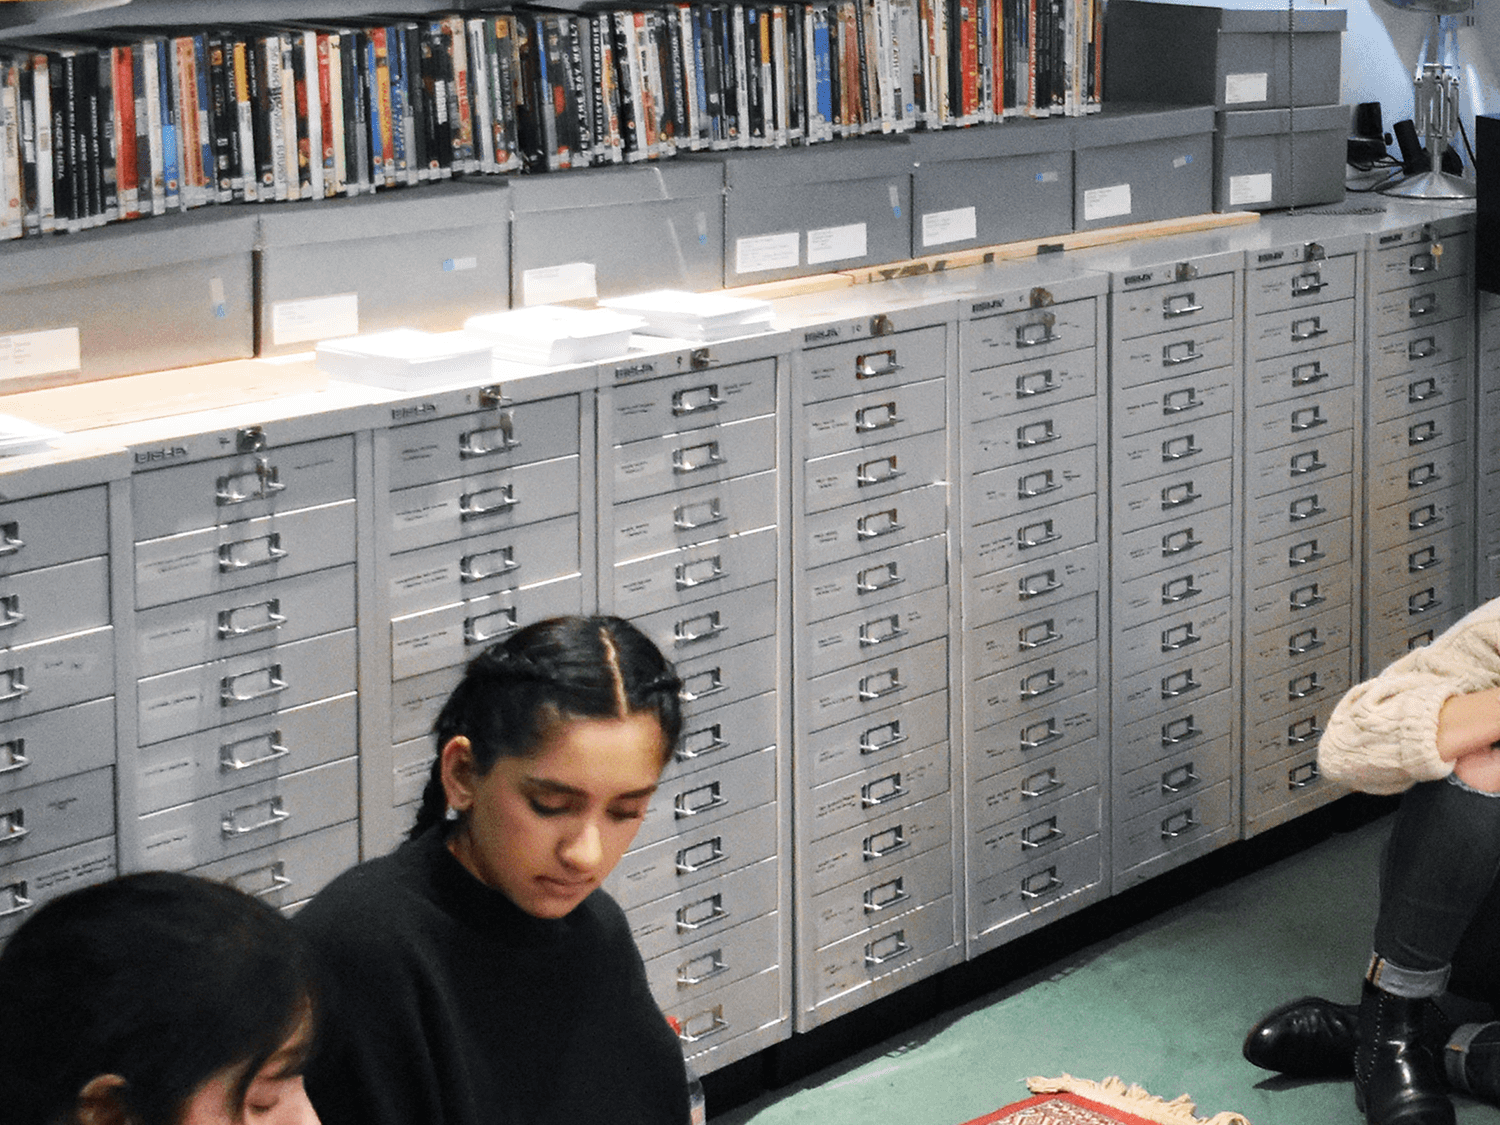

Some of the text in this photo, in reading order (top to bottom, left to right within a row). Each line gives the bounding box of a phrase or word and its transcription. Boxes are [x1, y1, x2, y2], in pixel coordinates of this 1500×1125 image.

[592, 20, 602, 83] HARMONIES
[573, 69, 583, 91] DAY
[576, 97, 586, 119] THE
